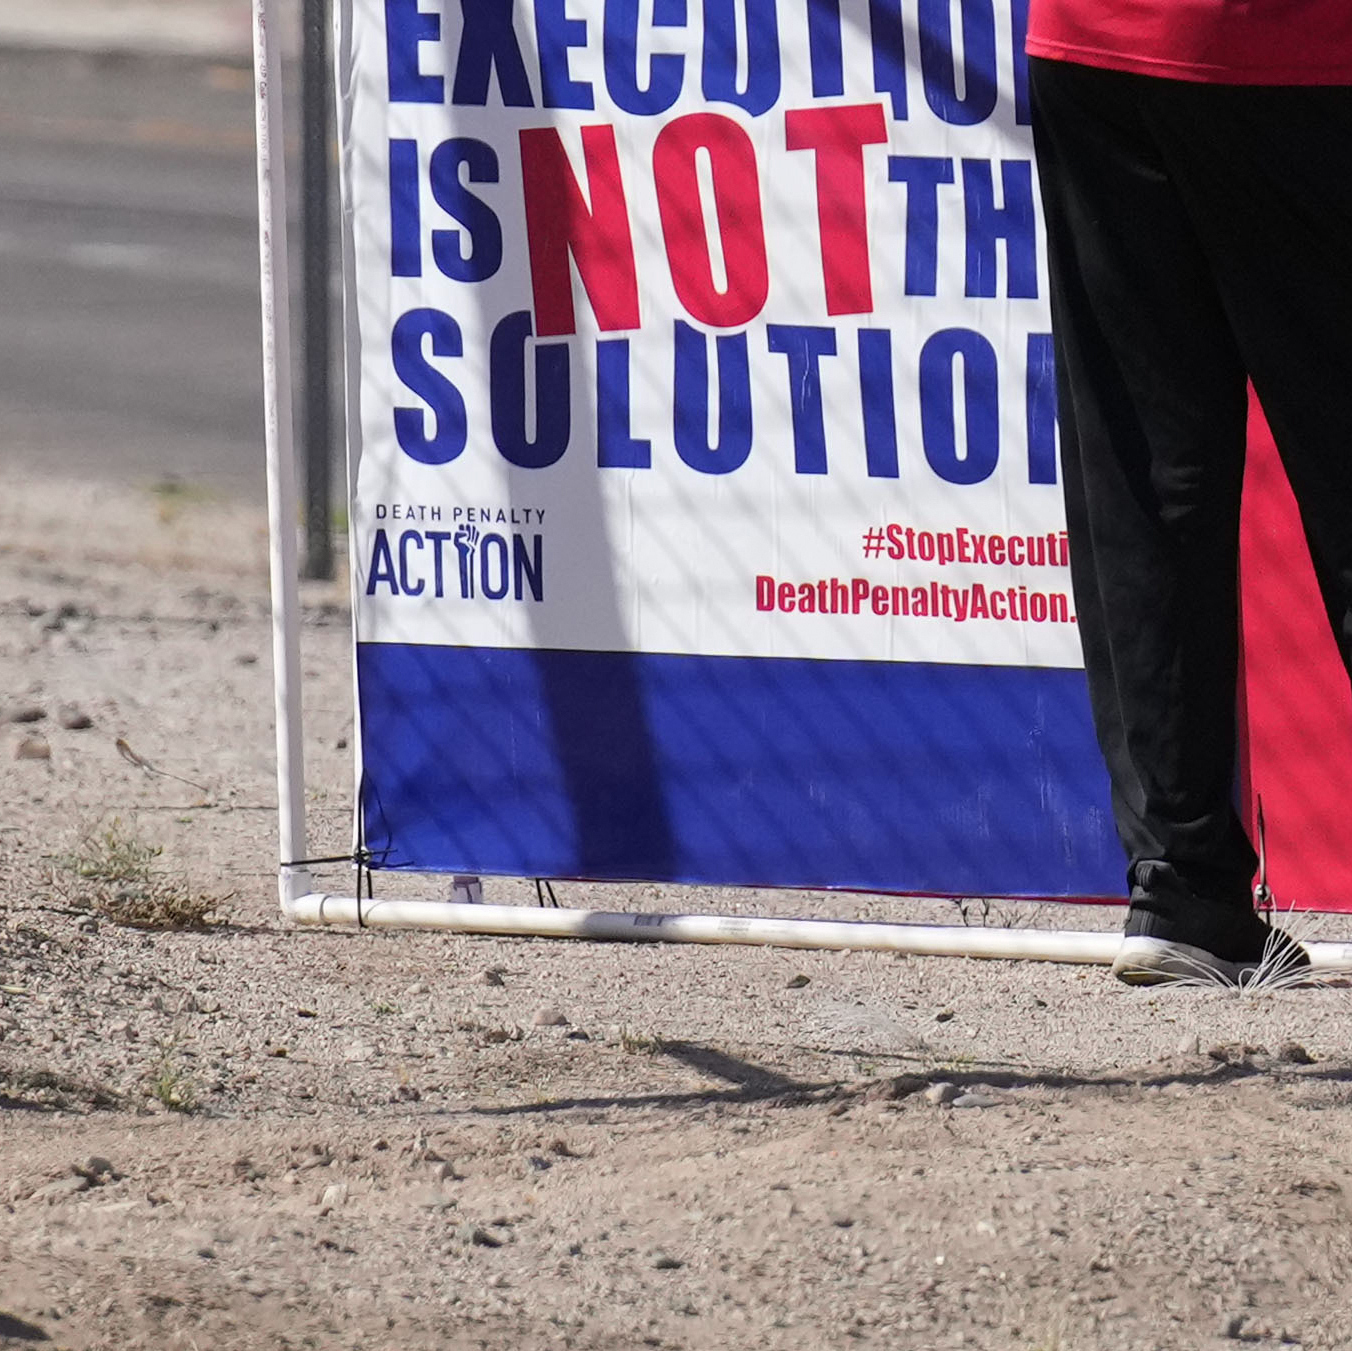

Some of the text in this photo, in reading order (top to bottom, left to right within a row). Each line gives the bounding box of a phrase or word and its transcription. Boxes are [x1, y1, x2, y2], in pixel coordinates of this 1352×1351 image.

[389, 139, 500, 283] IS
[519, 103, 889, 338] NOT
[375, 504, 547, 526] DEATH PENALTY
[366, 524, 543, 602] ACTION
